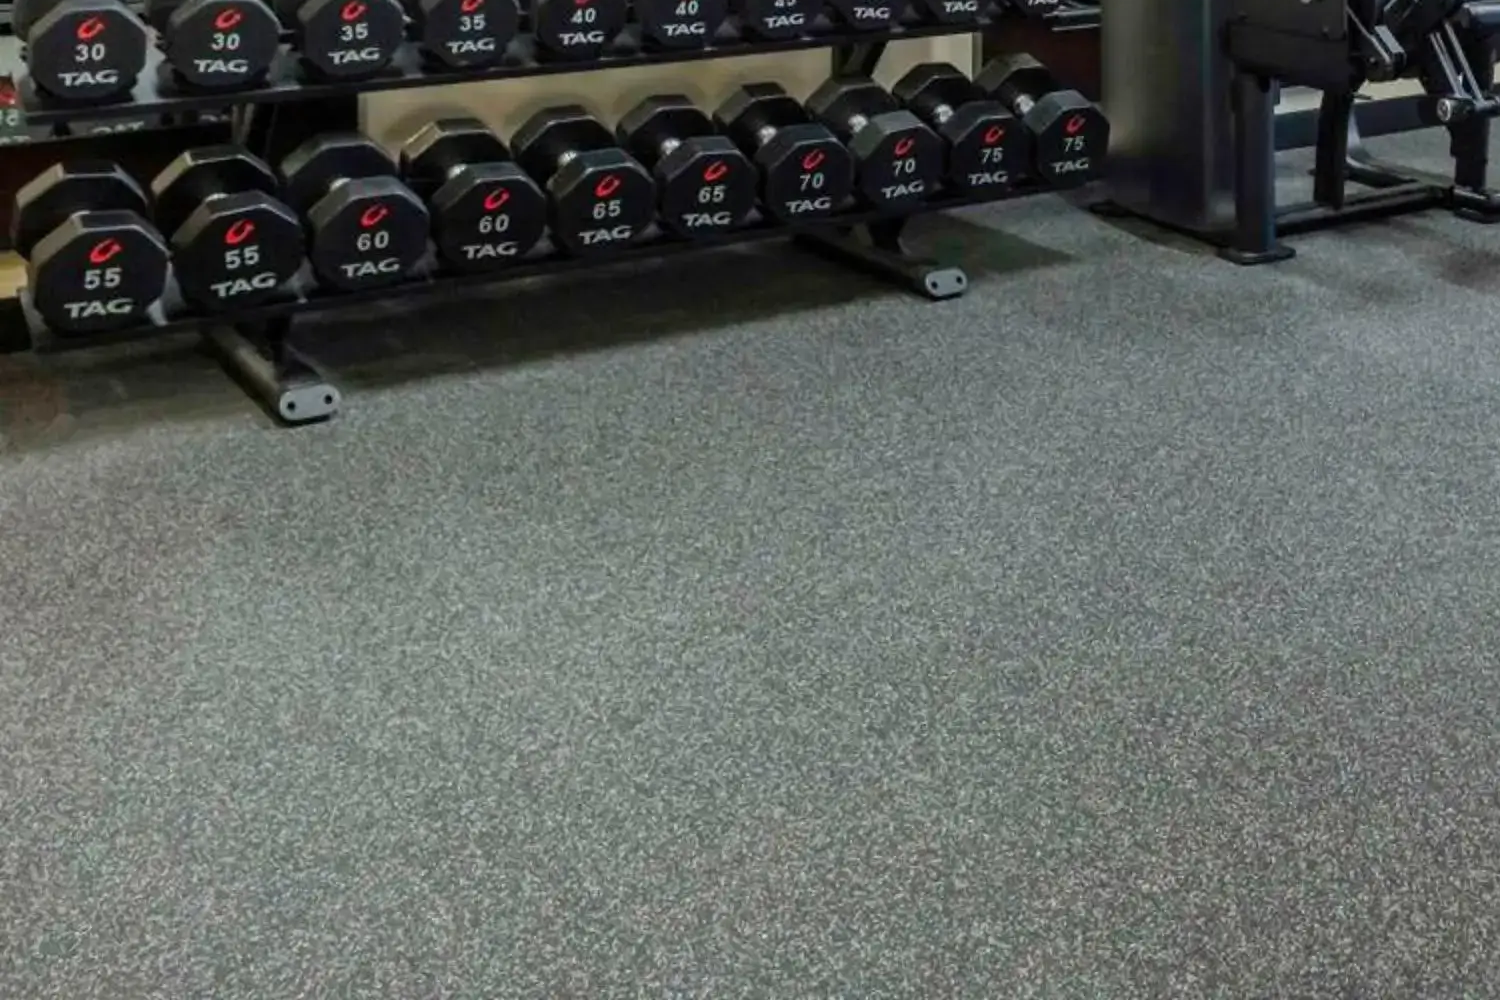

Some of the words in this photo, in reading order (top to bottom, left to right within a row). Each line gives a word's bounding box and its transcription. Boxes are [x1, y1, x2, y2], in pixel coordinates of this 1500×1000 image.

[570, 7, 597, 24] 40
[675, 0, 699, 16] 40
[853, 6, 890, 19] TAG
[943, 0, 978, 13] TAG
[459, 13, 486, 32] 35
[662, 21, 706, 37] TAG
[764, 13, 805, 29] TAG
[340, 22, 369, 42] 35
[559, 30, 605, 45] TAG
[210, 32, 241, 51] 30
[446, 37, 495, 55] TAG
[75, 43, 106, 62] 30
[327, 47, 380, 65] TAG
[193, 59, 249, 73] TAG
[57, 69, 118, 87] TAG
[1064, 135, 1085, 153] 75
[982, 146, 1004, 164] 75
[893, 157, 916, 176] 70
[1052, 157, 1089, 173] TAG
[799, 172, 825, 191] 70
[968, 170, 1009, 185] TAG
[698, 185, 726, 204] 65
[881, 180, 925, 199] TAG
[592, 199, 621, 220] 65
[785, 196, 831, 214] TAG
[478, 213, 510, 234] 60
[682, 211, 731, 227] TAG
[356, 230, 390, 252] 60
[578, 225, 632, 245] TAG
[224, 244, 260, 270] 55
[462, 241, 518, 259] TAG
[340, 257, 400, 278] TAG
[83, 267, 122, 290] 55
[210, 272, 277, 298] TAG
[63, 298, 133, 319] TAG
